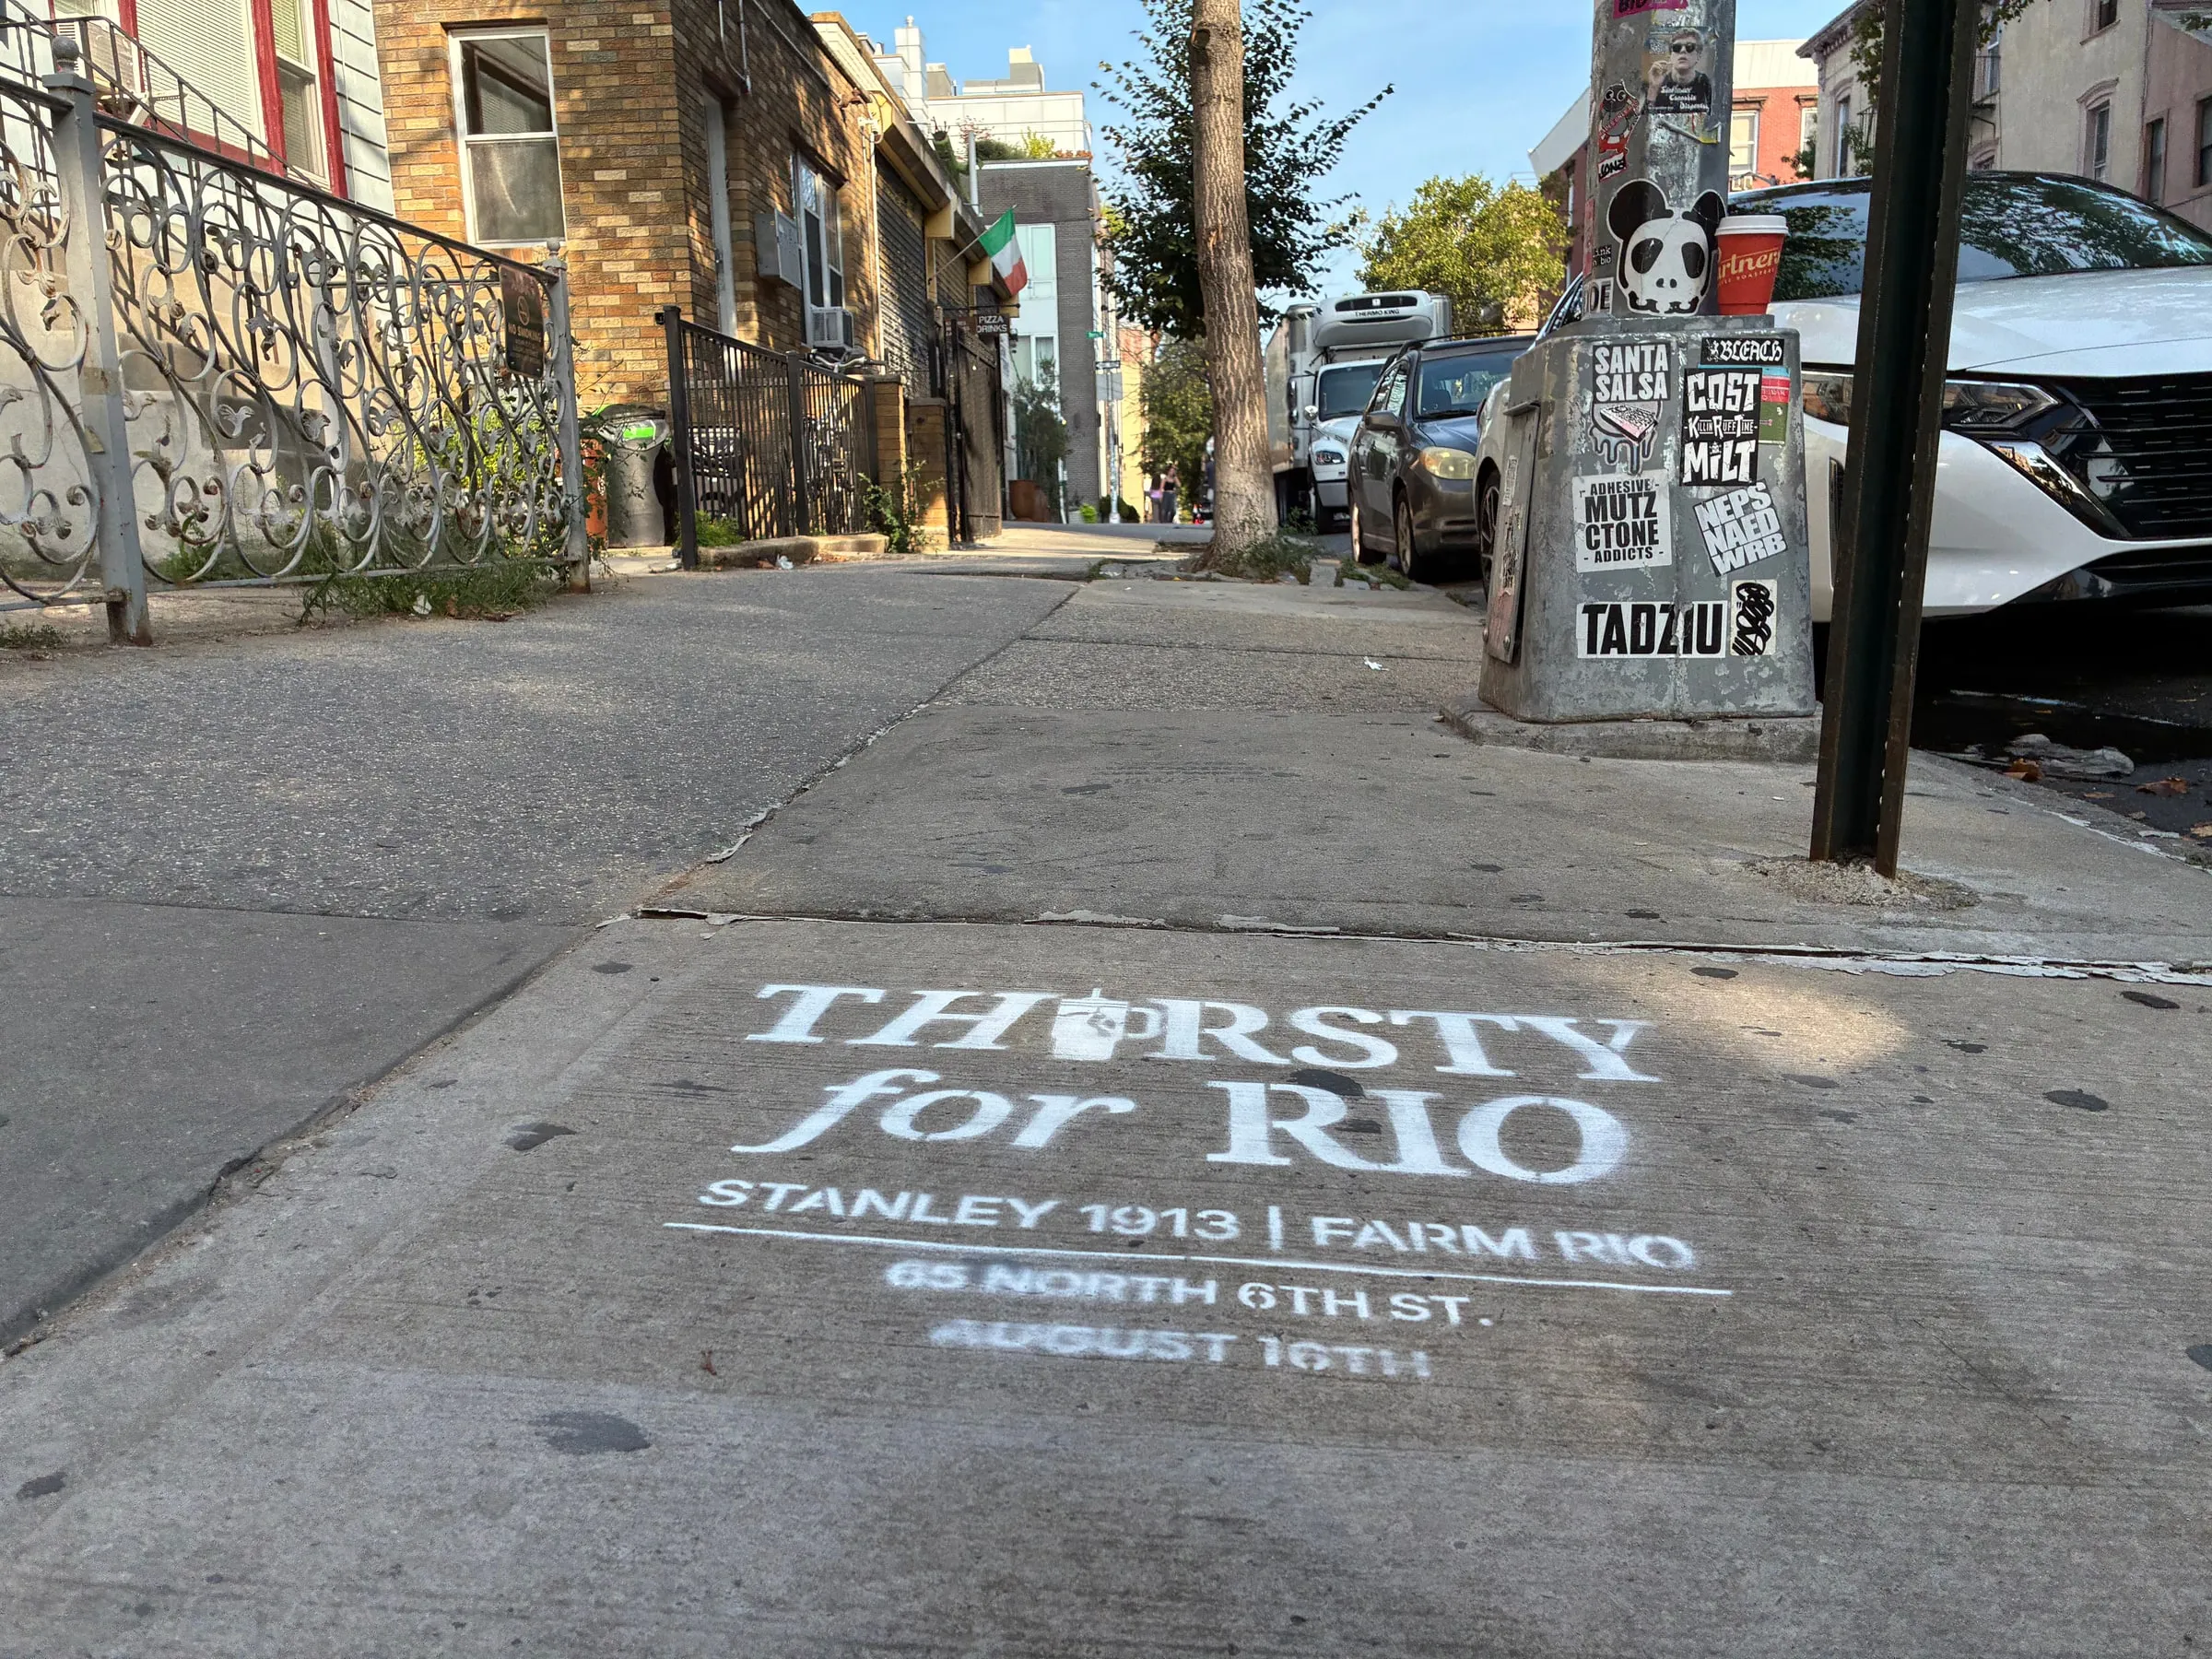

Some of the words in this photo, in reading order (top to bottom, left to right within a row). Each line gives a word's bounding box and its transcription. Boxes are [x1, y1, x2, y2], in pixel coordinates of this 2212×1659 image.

[1718, 247, 1781, 280] artners
[977, 324, 1007, 334] DRINKS
[979, 315, 1004, 324] PIZZA
[1594, 344, 1668, 374] SANTA
[1595, 372, 1667, 402] SALSA
[1687, 372, 1759, 412] COST
[1590, 478, 1652, 496] ADHESIVE
[1584, 490, 1657, 524] MUTZ
[1694, 482, 1771, 532] NEPS
[1585, 519, 1659, 550] CTONE
[1703, 507, 1781, 557] NAED
[1594, 546, 1653, 563] ADDICTS
[1712, 533, 1786, 574] WRB
[1582, 604, 1723, 654] TADZIU
[731, 1068, 1135, 1152] for
[1206, 1080, 1630, 1184] RIO
[699, 1179, 1062, 1228] STANLEY
[1079, 1204, 1241, 1240] 1913
[1311, 1216, 1540, 1260] FARM
[1554, 1230, 1695, 1270] RIO
[883, 1259, 968, 1291] 65
[982, 1265, 1218, 1306] NORTH
[1238, 1282, 1372, 1319] 6TH
[1389, 1293, 1493, 1326] ST.
[1257, 1336, 1431, 1379] 16TH
